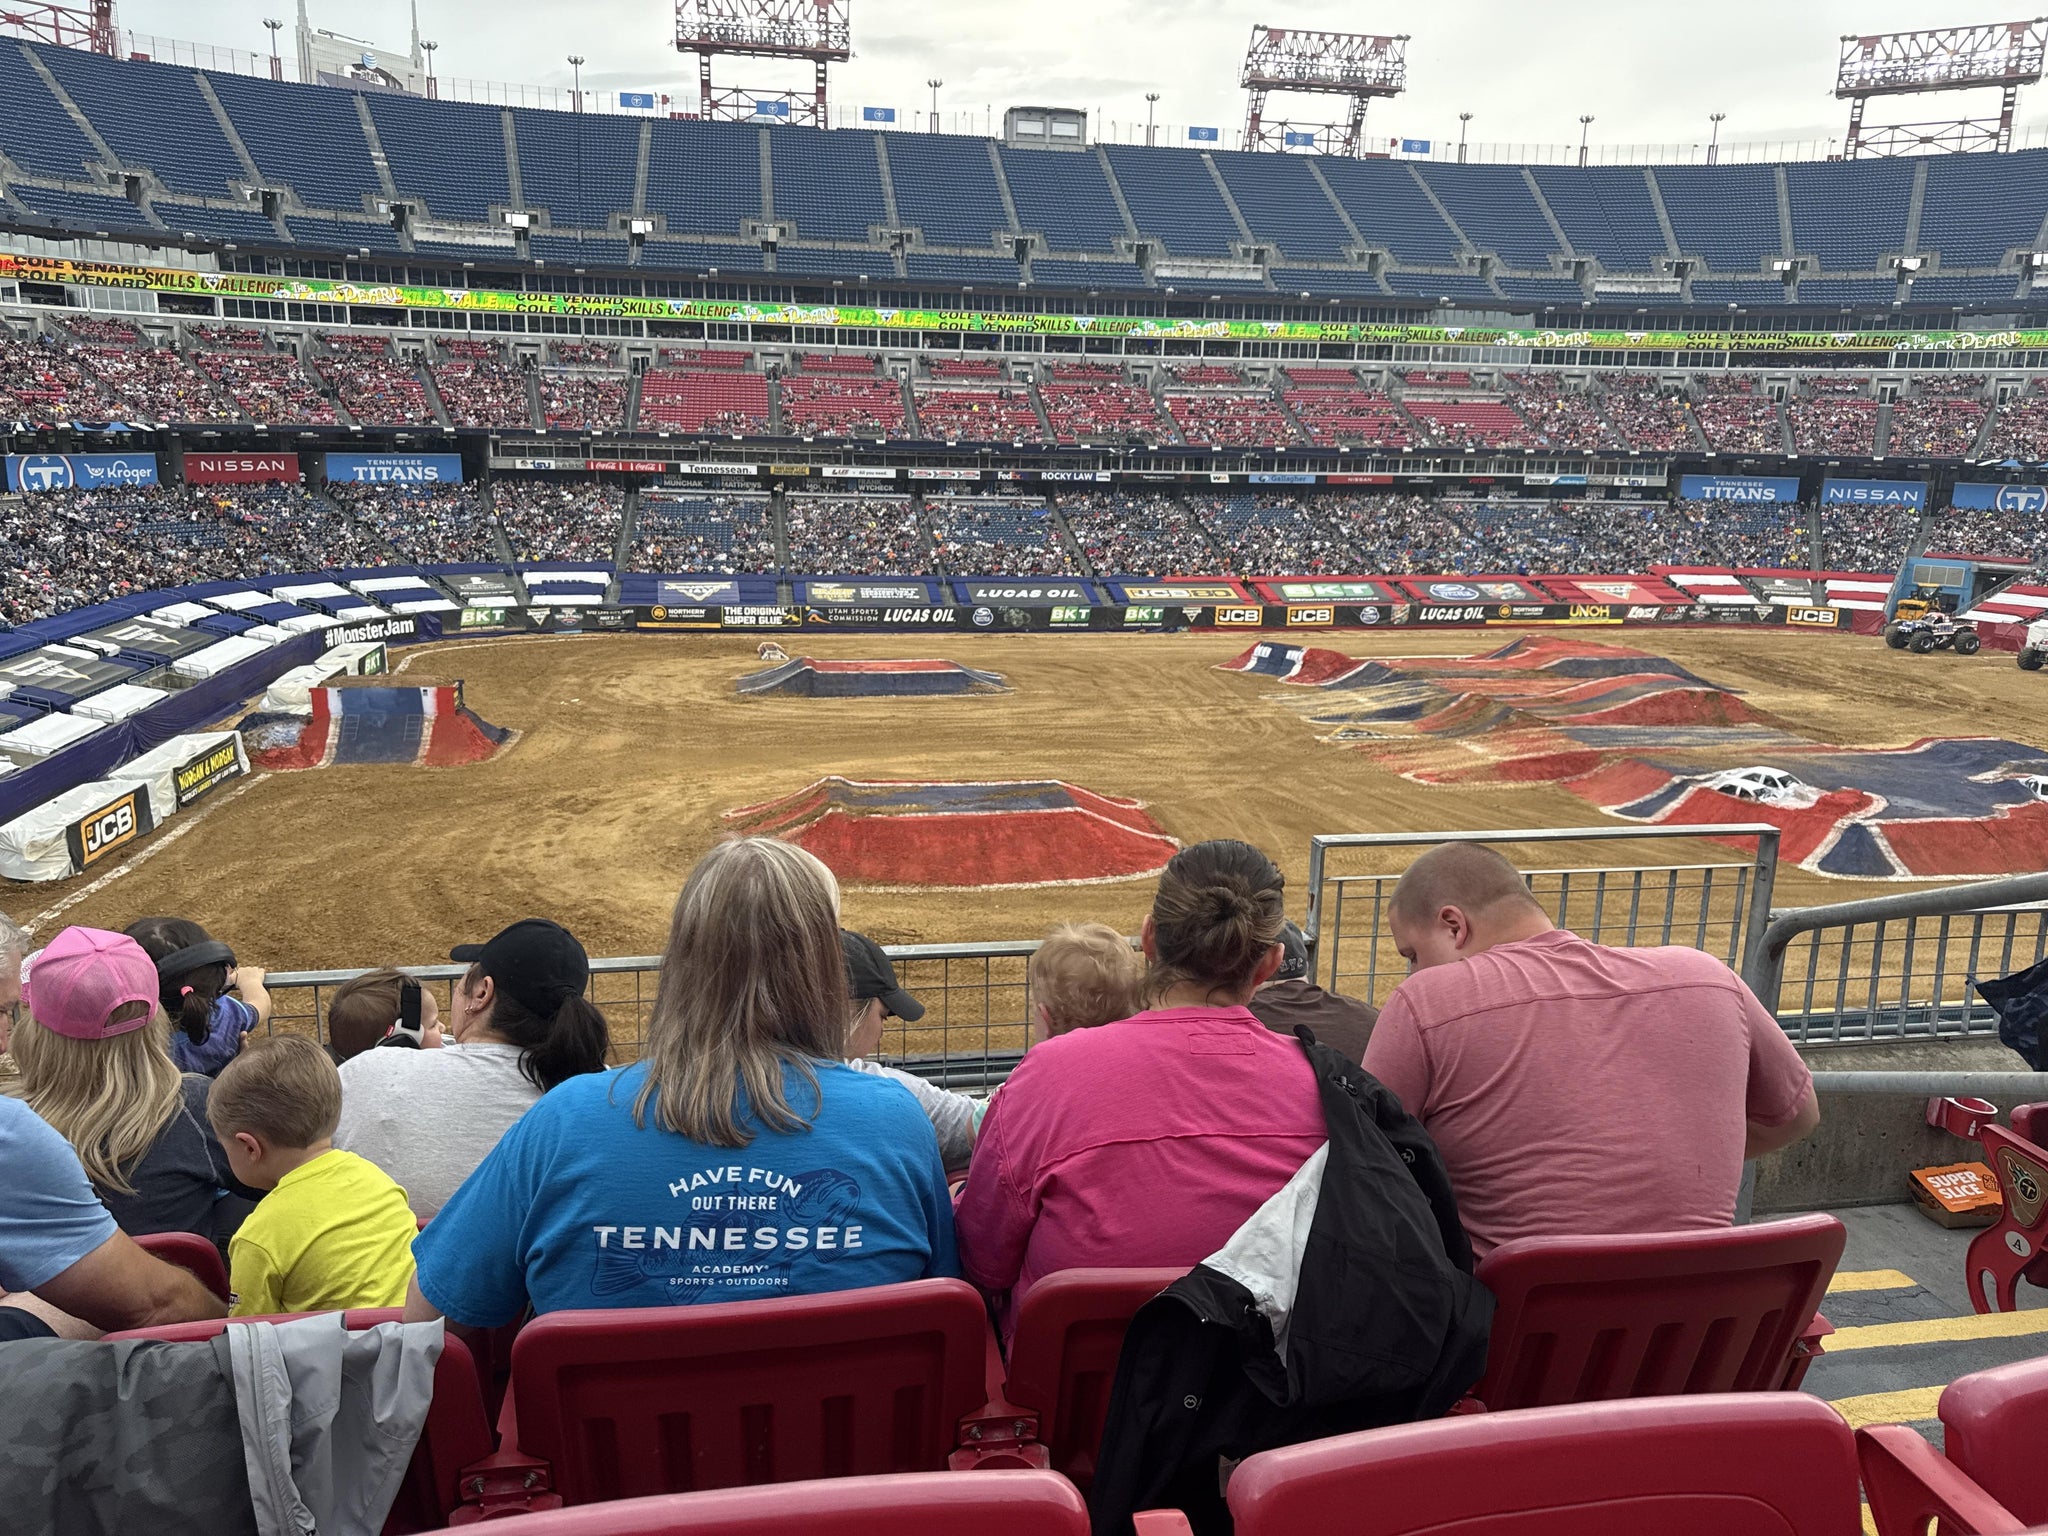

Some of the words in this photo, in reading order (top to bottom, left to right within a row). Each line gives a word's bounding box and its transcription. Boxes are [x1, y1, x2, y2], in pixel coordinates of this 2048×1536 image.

[14, 256, 64, 269] COLE
[71, 261, 147, 276] VENARD
[16, 269, 66, 282] COLE
[72, 274, 148, 289] VENARD
[146, 272, 195, 288] SKILLS
[200, 277, 285, 295] CALLENGE
[515, 293, 556, 302] COLE
[562, 296, 623, 305] VENARD
[515, 304, 557, 313] COLE
[563, 305, 623, 317] VENARD
[622, 302, 663, 315] SKILLS
[667, 303, 738, 318] CALLENGE
[939, 312, 975, 320] COLE
[980, 313, 1035, 322] VENARD
[939, 322, 975, 331] COLE
[981, 323, 1035, 333] VENARD
[1033, 319, 1070, 332] SKILLS
[1074, 320, 1138, 332] CALLENGE
[1320, 323, 1353, 332] COLE
[1358, 324, 1408, 333] VENARD
[1320, 333, 1353, 342] COLE
[1357, 334, 1408, 343] VENARD
[1407, 329, 1441, 342] SKILLS
[1444, 330, 1503, 344] CALLENGE
[1687, 332, 1723, 340] COLE
[1729, 332, 1788, 341] VENARD
[1786, 335, 1827, 348] SKILLS
[1831, 335, 1906, 348] CALLENGE
[1911, 334, 1930, 344] THE
[1956, 331, 2020, 349] PEARL
[1686, 341, 1723, 350] COLE
[1729, 342, 1787, 350] VENARD
[107, 460, 152, 485] Kroger
[200, 460, 286, 472] NISSAN
[352, 466, 439, 481] TITANS
[1041, 472, 1072, 480] ROCKY
[1073, 472, 1093, 480] LAW
[1714, 480, 1764, 488] TENNESSEE
[1702, 486, 1776, 500] TITANS
[1829, 488, 1919, 501] NISSAN
[976, 590, 1042, 598] LUCAS
[1047, 590, 1078, 598] OIL
[1132, 590, 1188, 598] JCB
[462, 609, 505, 622] BKT
[724, 606, 743, 616] THE
[744, 606, 786, 616] ORIGINAL
[883, 608, 930, 622] LUCAS
[932, 608, 955, 622] OIL
[1051, 608, 1090, 620] BKT
[1126, 608, 1164, 619] BKT
[1218, 610, 1258, 622] JCB
[1290, 609, 1330, 622] JCB
[1419, 607, 1462, 620] LUCAS
[1464, 606, 1485, 620] OIL
[1568, 605, 1610, 617] UNOH
[1791, 610, 1834, 623] JCB
[724, 616, 754, 624] SUPER
[760, 616, 783, 624] GLUE
[325, 619, 414, 648] #MonsterJam
[364, 651, 381, 672] BKT
[178, 762, 204, 790] MORGAN
[210, 744, 234, 772] MORGAN
[88, 805, 132, 852] JCB
[668, 1166, 743, 1199] HAVE
[748, 1167, 802, 1199] FUN
[1926, 1170, 1982, 1188] SUPER
[1938, 1183, 1984, 1200] SLICE
[691, 1196, 721, 1211] OUT
[727, 1196, 777, 1211] THERE
[593, 1225, 863, 1250] TENNESSEE
[2012, 1239, 2022, 1252] A
[669, 1278, 714, 1286] SPORTS
[726, 1278, 788, 1286] OUTDOORS
